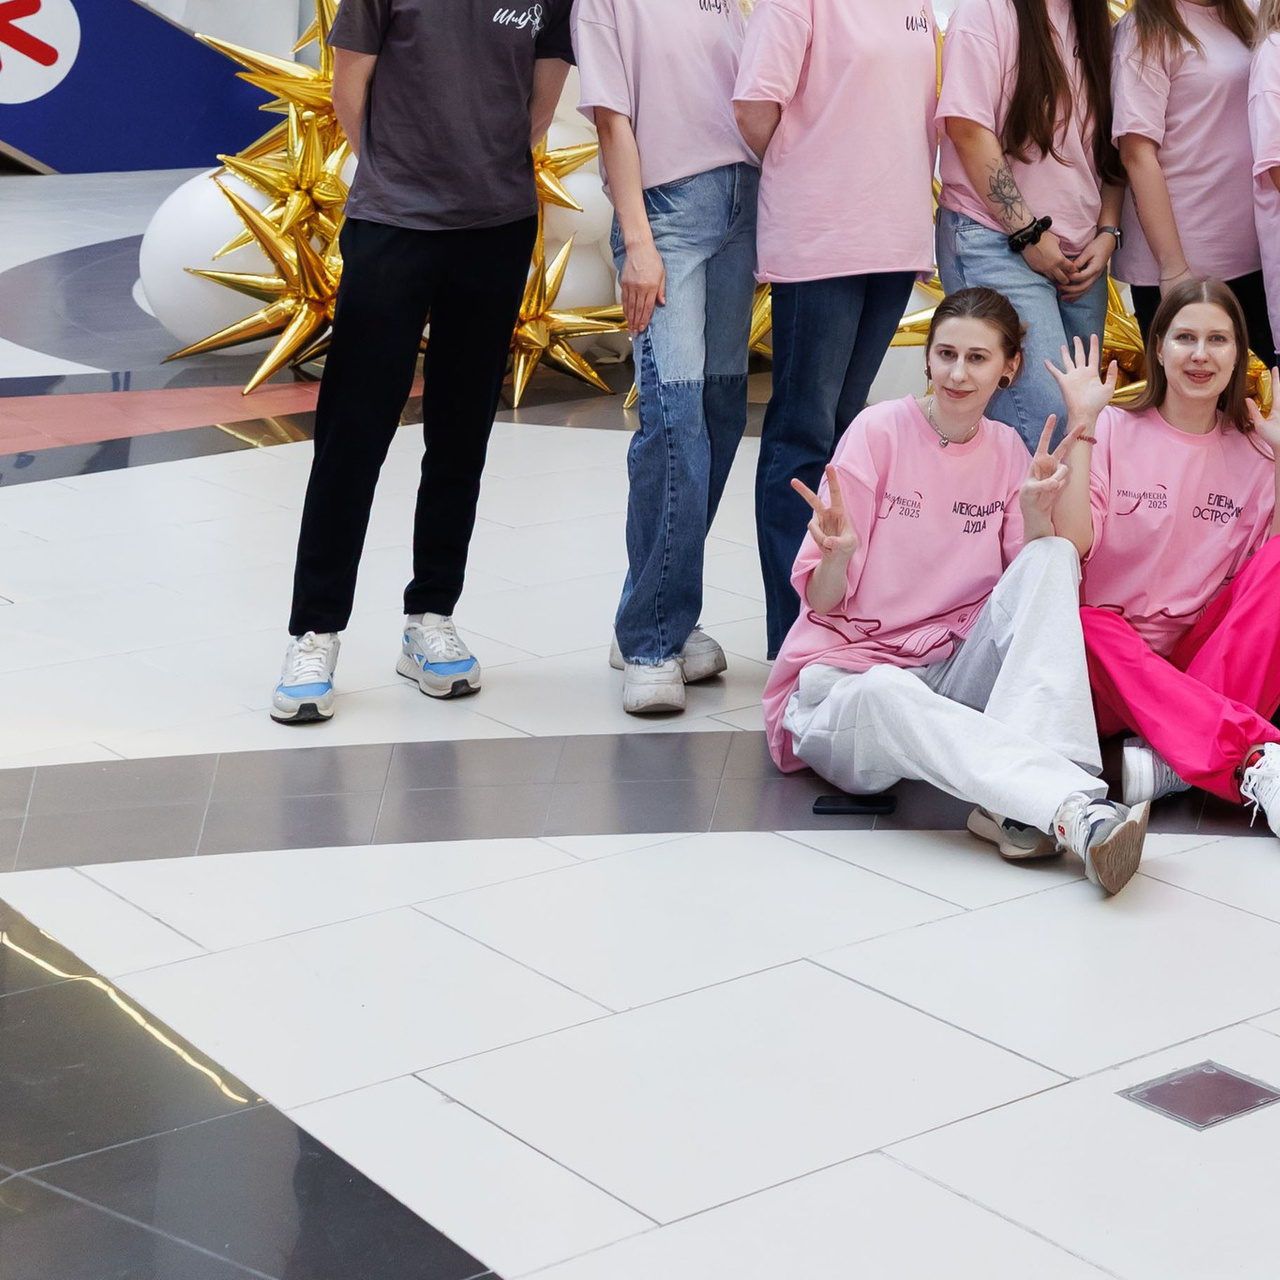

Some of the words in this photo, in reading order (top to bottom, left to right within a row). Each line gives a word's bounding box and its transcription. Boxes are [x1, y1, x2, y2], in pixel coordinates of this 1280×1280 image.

[1148, 499, 1168, 509] 2025
[1207, 492, 1235, 510] ЕЛЕНА
[898, 506, 921, 519] 2025
[962, 519, 987, 534] ДУДА
